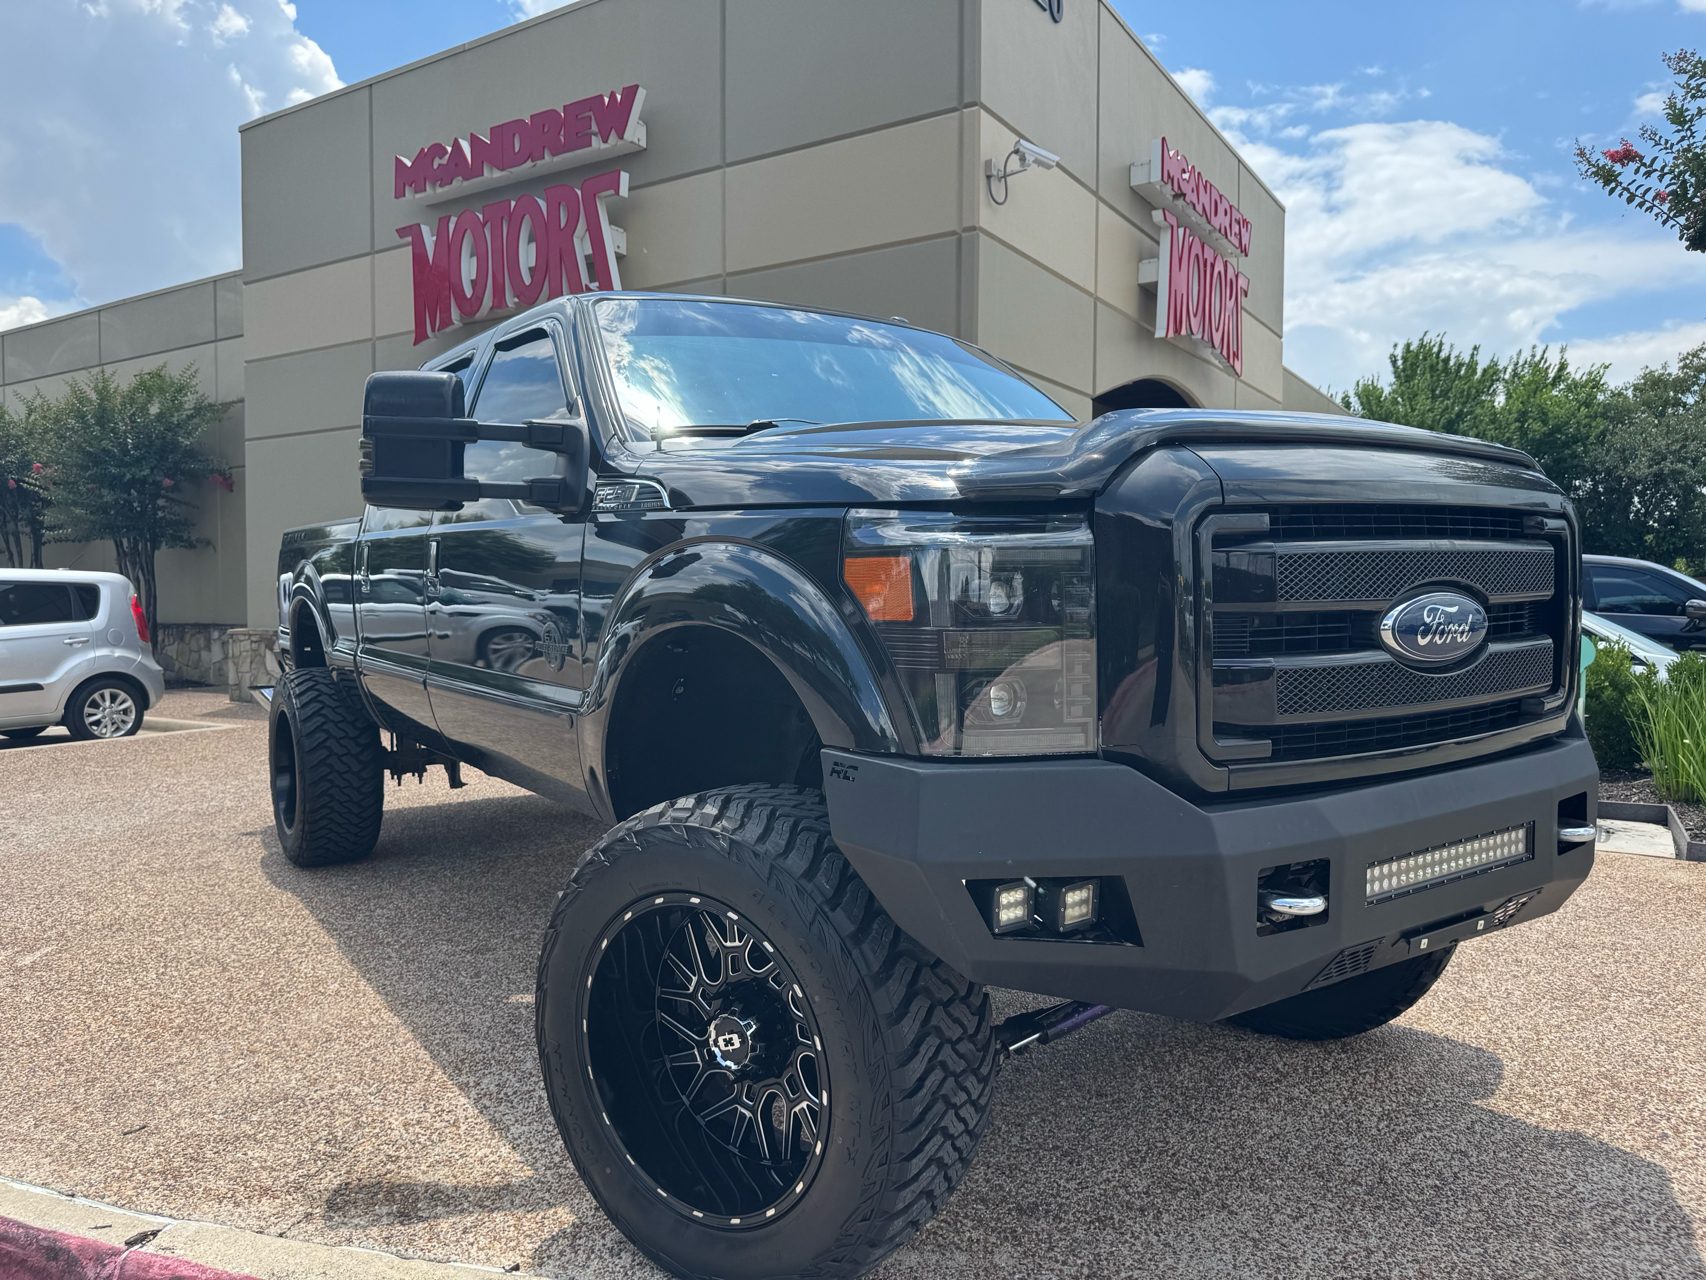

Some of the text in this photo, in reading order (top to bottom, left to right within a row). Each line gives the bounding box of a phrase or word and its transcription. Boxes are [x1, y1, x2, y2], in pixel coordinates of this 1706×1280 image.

[395, 168, 622, 346] MOTORS
[1162, 208, 1250, 378] MOTORS
[1417, 604, 1473, 646] Ford
